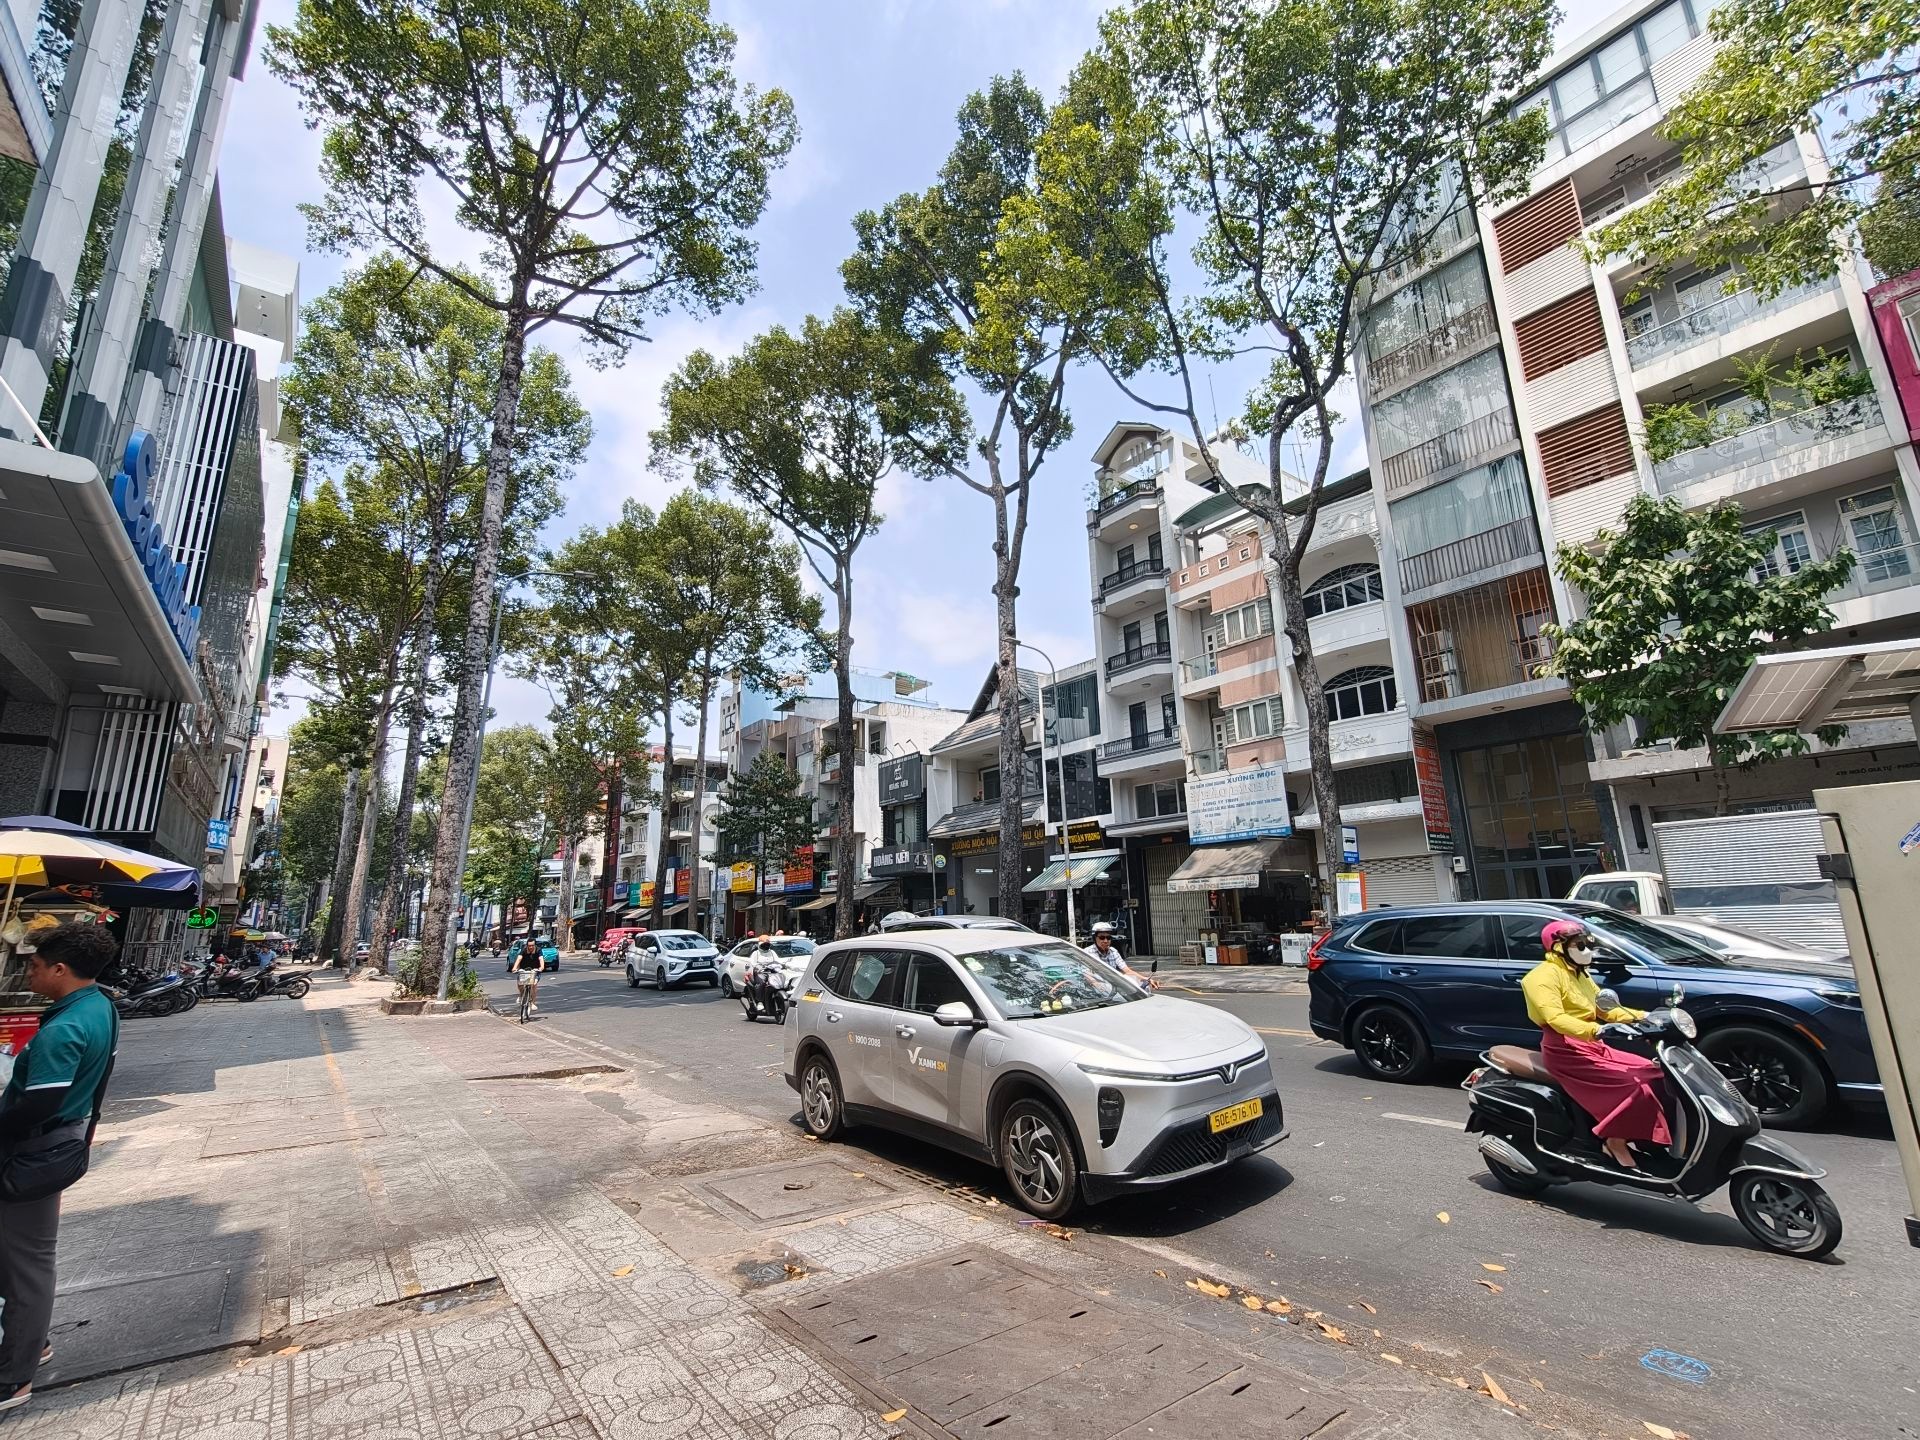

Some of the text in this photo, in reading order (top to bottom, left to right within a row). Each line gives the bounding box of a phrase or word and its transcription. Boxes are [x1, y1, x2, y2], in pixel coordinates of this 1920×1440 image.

[1257, 770, 1277, 780] MỘC
[972, 835, 986, 848] MỘC
[986, 833, 998, 848] NỘI
[873, 853, 894, 867] HOÀNG
[855, 1034, 881, 1048] 1900 2088
[918, 1057, 937, 1070] XANH
[936, 1061, 947, 1072] SM
[1214, 1102, 1258, 1128] 50E-576.10
